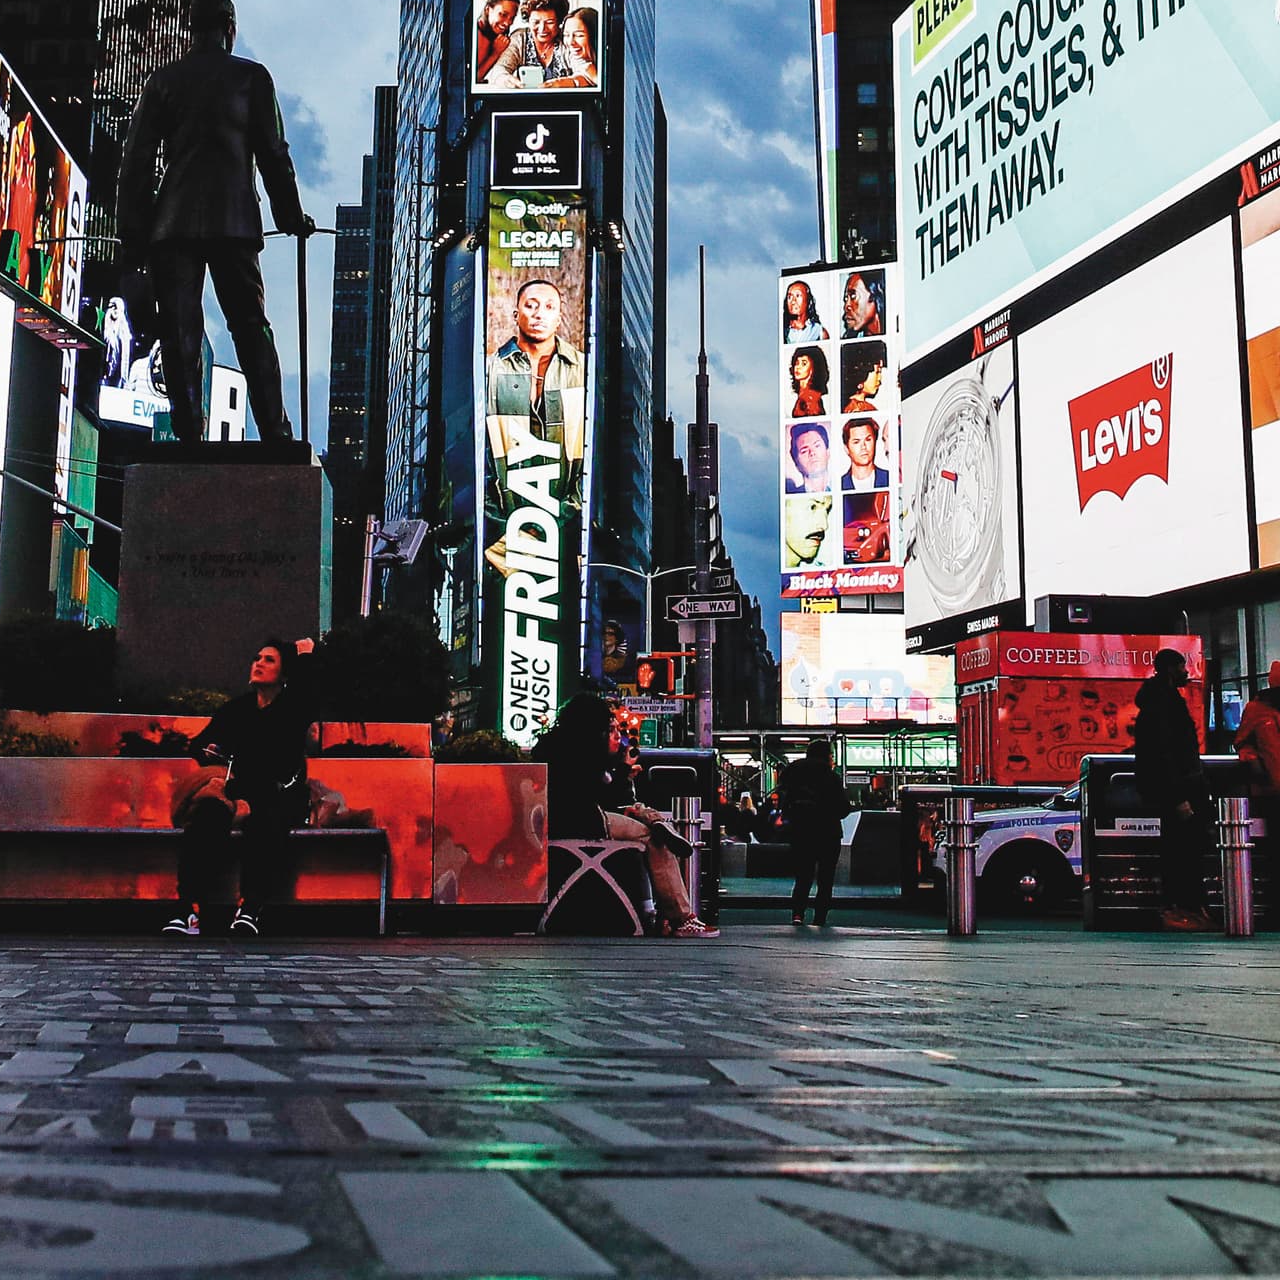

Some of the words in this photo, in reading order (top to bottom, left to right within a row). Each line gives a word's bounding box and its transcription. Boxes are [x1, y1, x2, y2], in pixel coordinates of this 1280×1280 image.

[913, 38, 990, 147] COVER
[914, 120, 970, 214] WITH
[975, 23, 1094, 164] TISSUES,
[516, 153, 557, 164] TikTok
[527, 203, 569, 216] Spotify
[915, 184, 981, 281] THEM
[986, 119, 1064, 235] AWAY.
[499, 231, 573, 248] LECRAE
[985, 326, 1008, 348] MARQUIS
[504, 424, 561, 650] FRIDAY
[789, 575, 833, 591] Black
[837, 571, 900, 590] Monday
[678, 603, 700, 612] ONE
[709, 602, 732, 612] WAY
[967, 620, 981, 634] SWISS
[981, 616, 995, 631] MADE
[1006, 647, 1091, 665] COFFEED
[511, 651, 529, 710] NEW
[1011, 818, 1043, 827] POLICE
